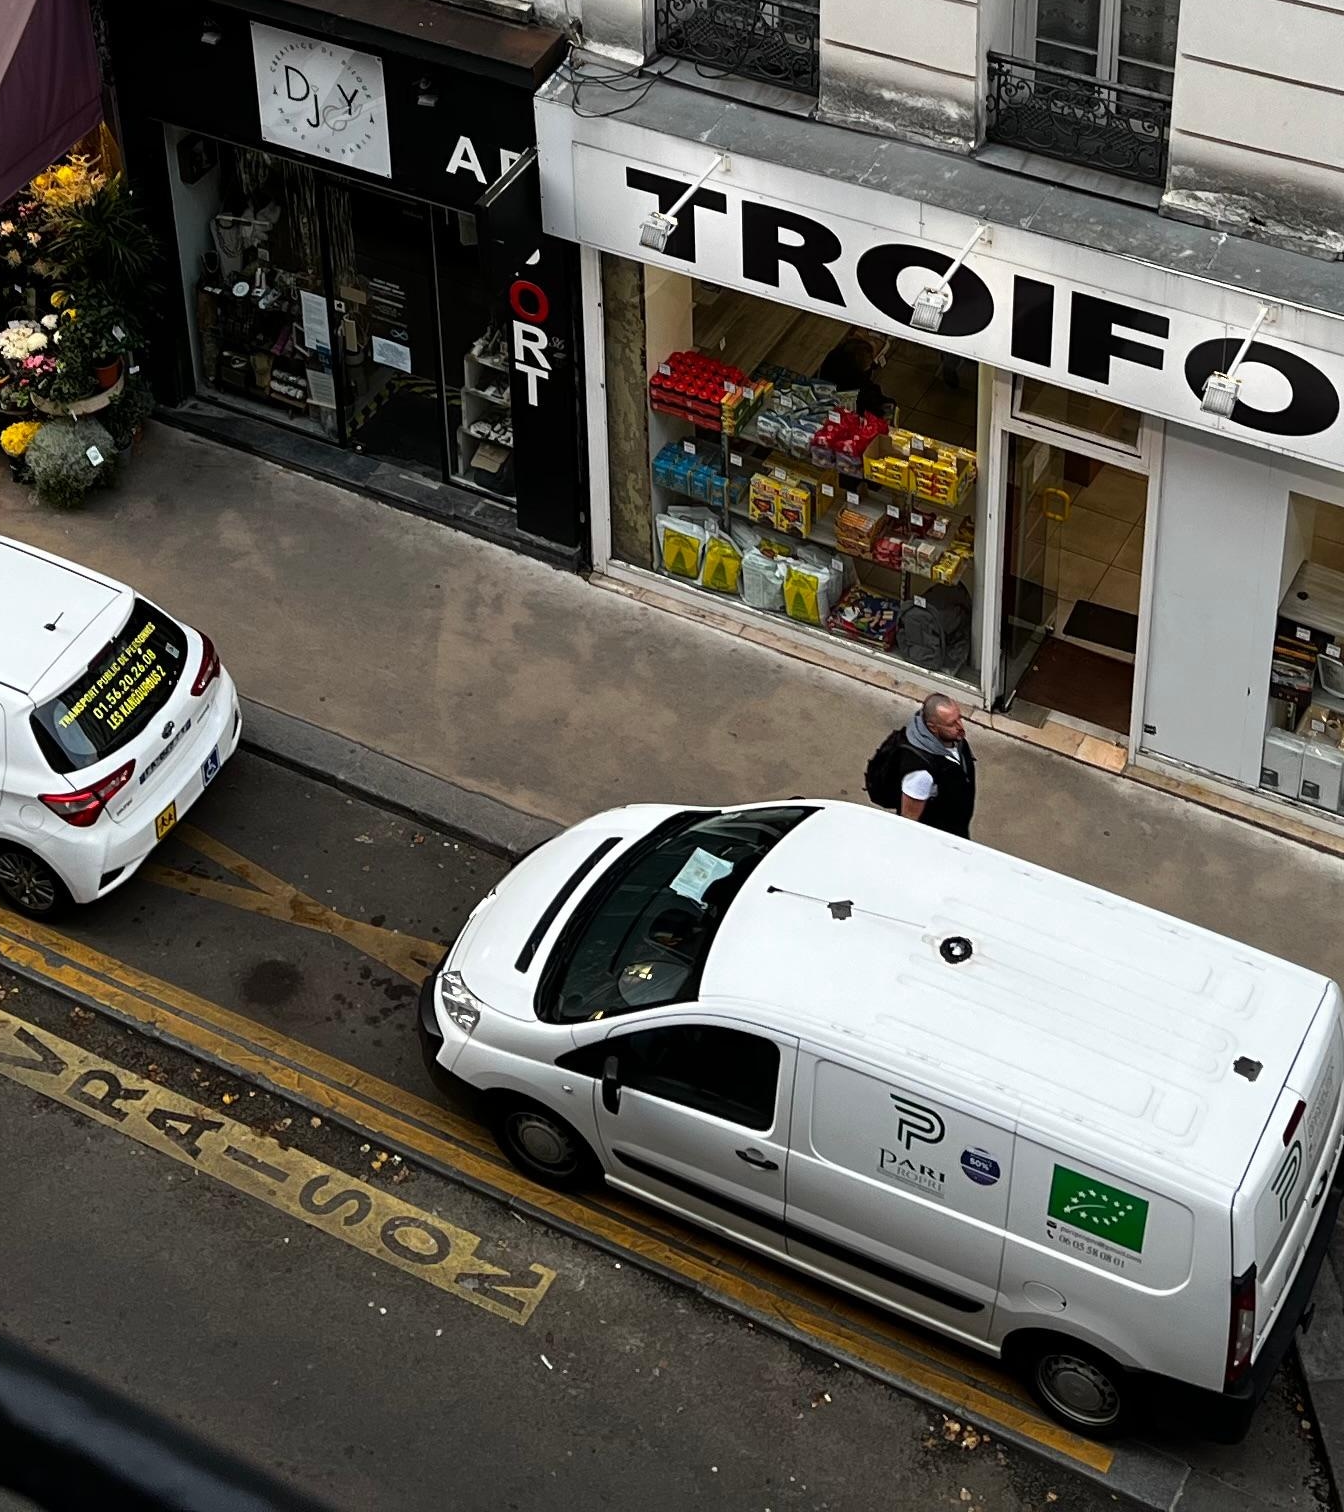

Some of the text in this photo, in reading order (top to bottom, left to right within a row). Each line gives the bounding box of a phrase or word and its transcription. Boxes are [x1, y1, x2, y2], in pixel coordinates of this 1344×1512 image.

[58, 684, 100, 729] TRANSPORT
[96, 660, 122, 690] PUBLIC
[116, 651, 130, 666] DE
[106, 712, 125, 731] LES
[878, 1147, 946, 1184] PARI
